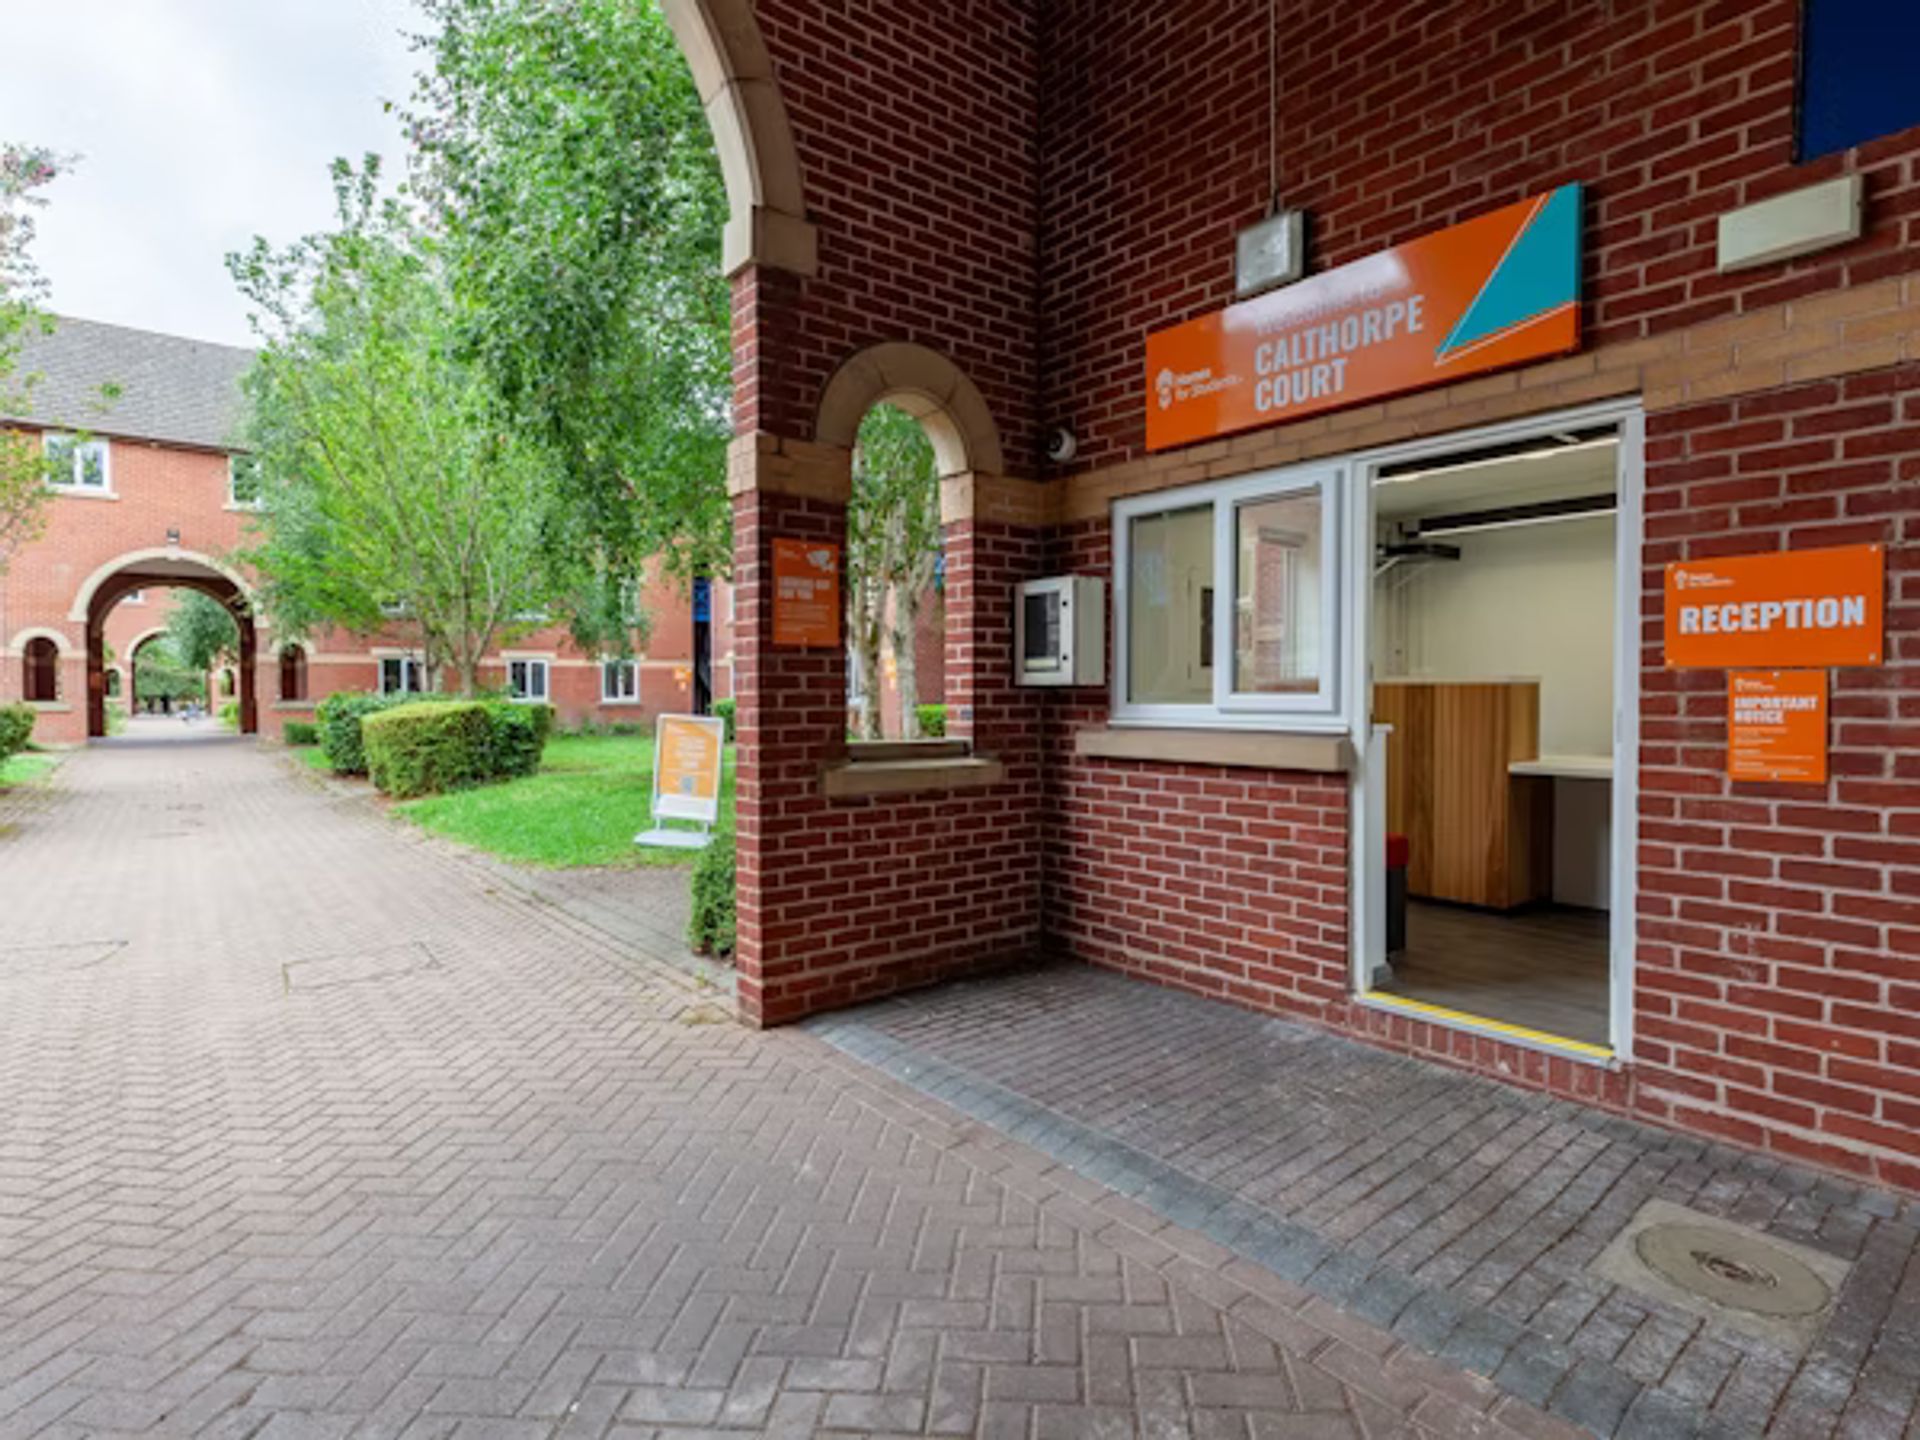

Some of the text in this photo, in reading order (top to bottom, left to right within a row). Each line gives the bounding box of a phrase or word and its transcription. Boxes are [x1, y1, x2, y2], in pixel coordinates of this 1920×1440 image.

[1255, 294, 1425, 376] CALTHORPE
[1254, 357, 1349, 412] COURT
[1678, 595, 1866, 635] RECEPTION
